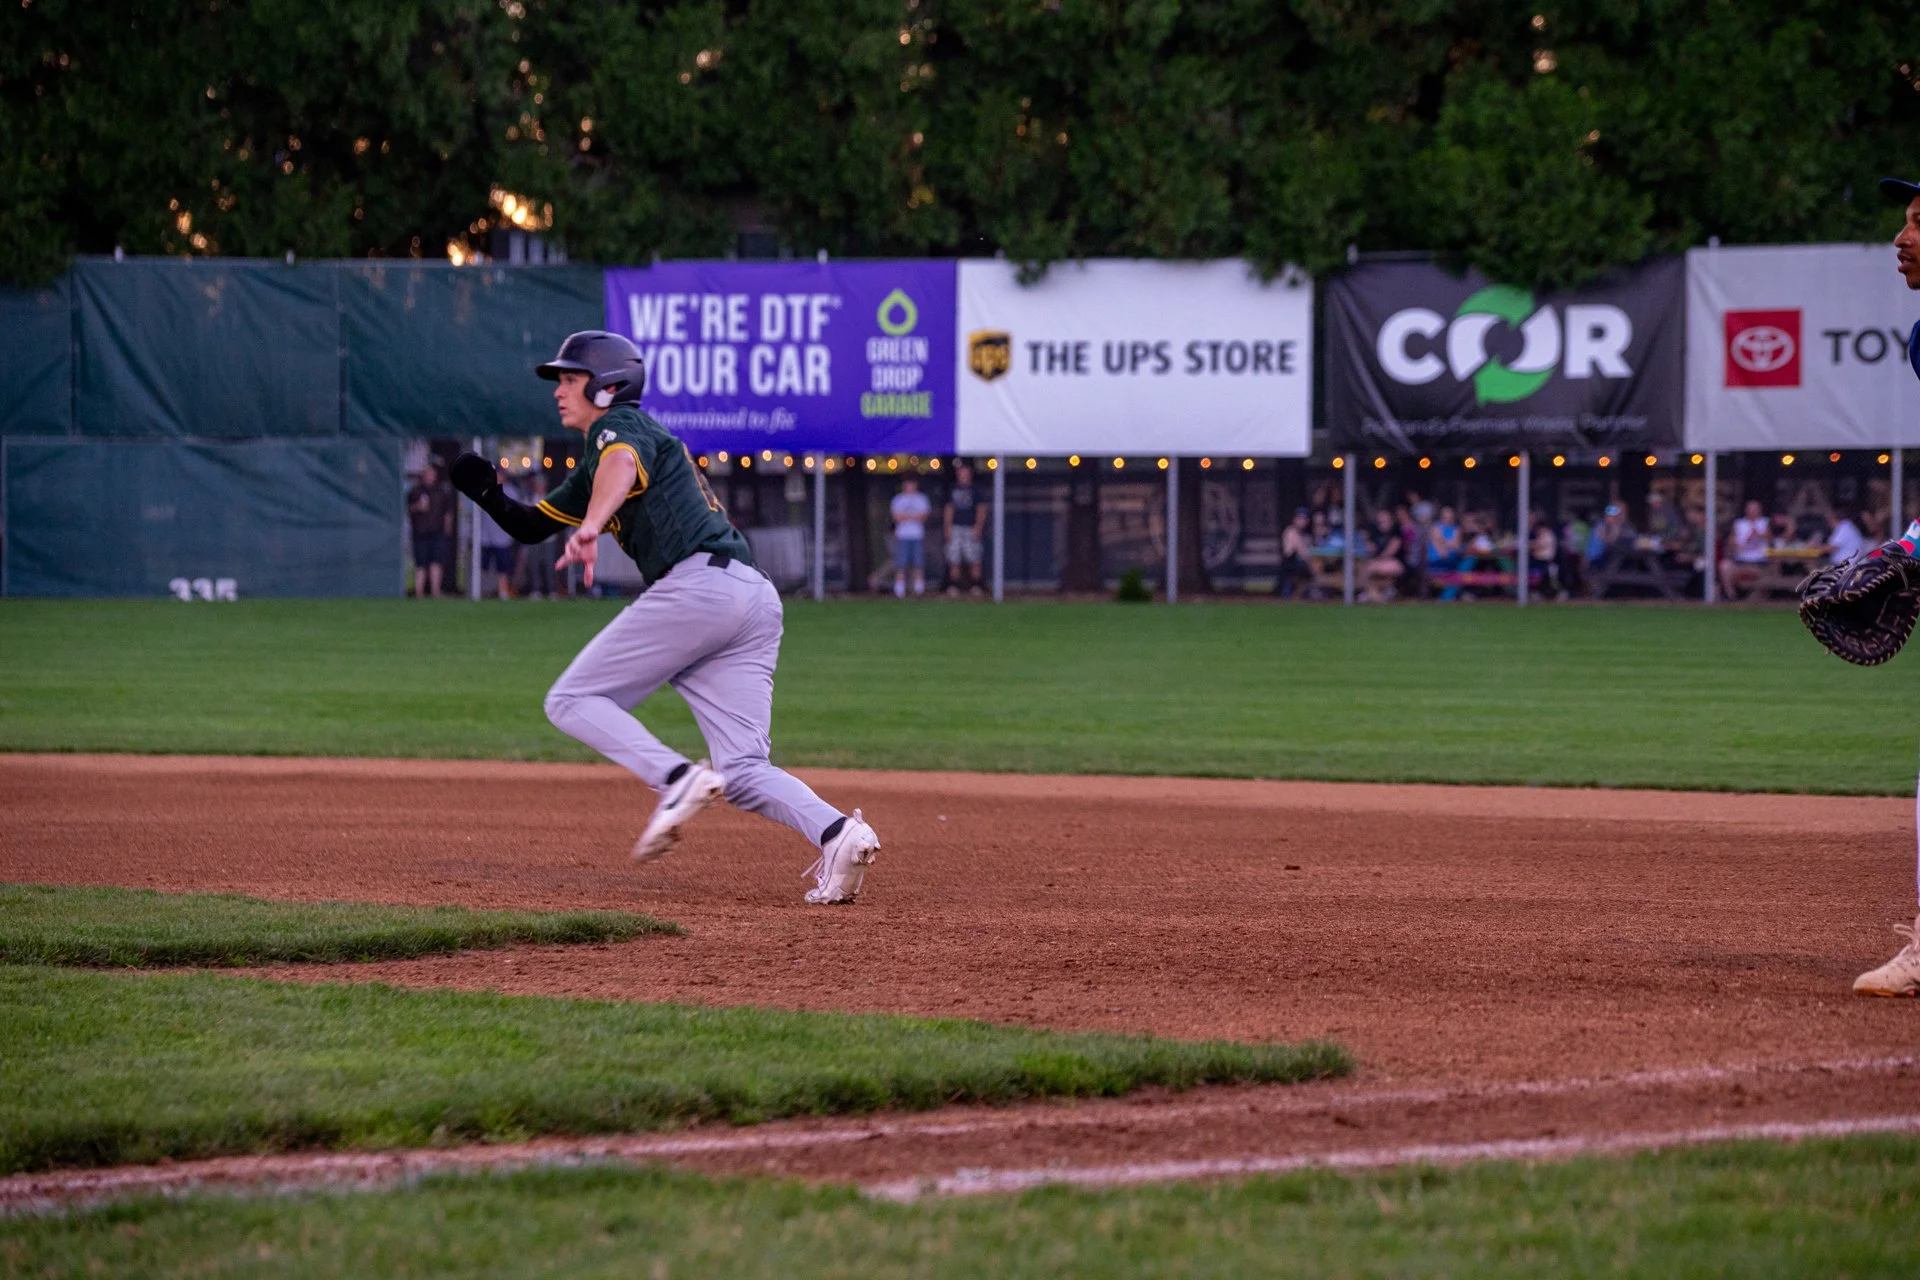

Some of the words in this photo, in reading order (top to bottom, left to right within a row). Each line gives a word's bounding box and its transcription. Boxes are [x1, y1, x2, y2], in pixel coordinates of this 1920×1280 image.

[629, 294, 750, 341] WE'RE
[866, 336, 929, 364] GREEN
[1025, 340, 1091, 376] THE
[1102, 340, 1173, 376] UPS
[1183, 340, 1297, 376] STORE
[1376, 300, 1635, 392] COR
[636, 344, 739, 396] YOUR
[749, 344, 832, 396] CAR
[871, 365, 924, 391] DROP
[861, 391, 934, 418] GARAGE
